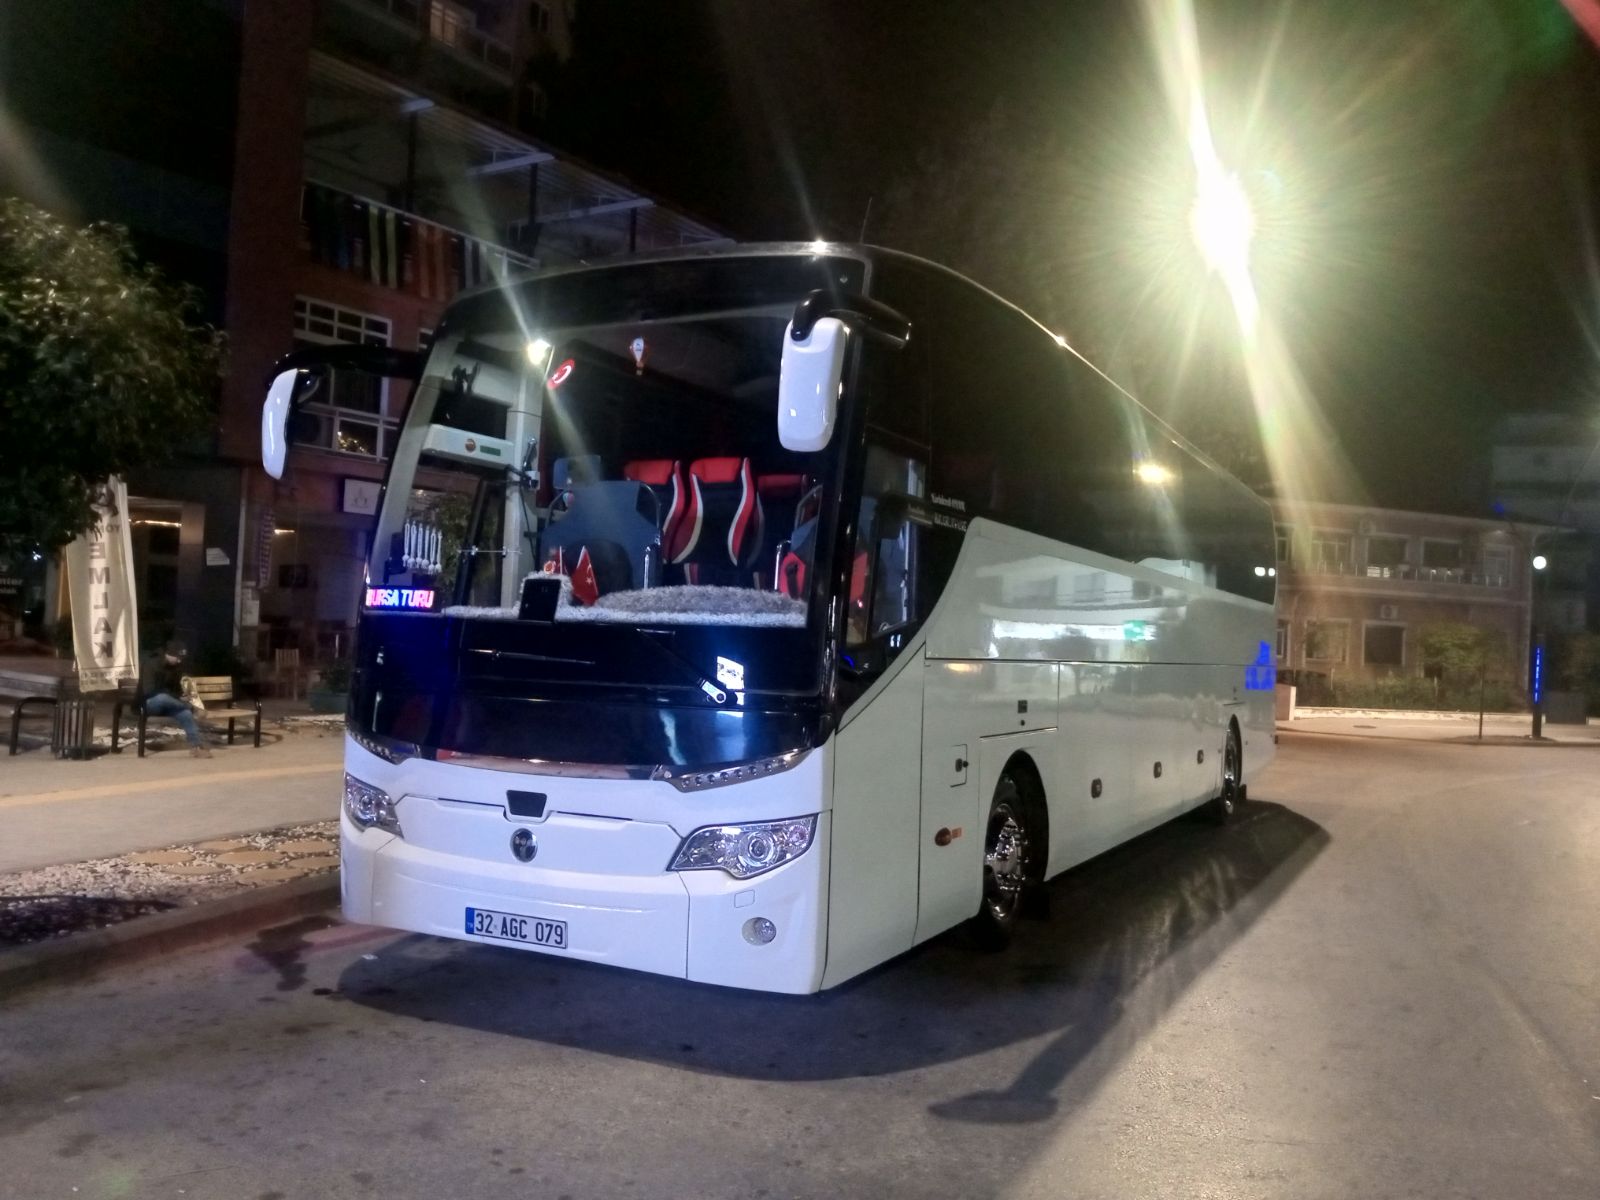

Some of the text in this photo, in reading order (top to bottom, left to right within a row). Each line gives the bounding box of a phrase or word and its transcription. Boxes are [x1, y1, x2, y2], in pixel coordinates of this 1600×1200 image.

[401, 589, 435, 608] TURU
[475, 912, 494, 934] 32
[500, 916, 528, 940] AGC
[535, 922, 564, 946] 079
